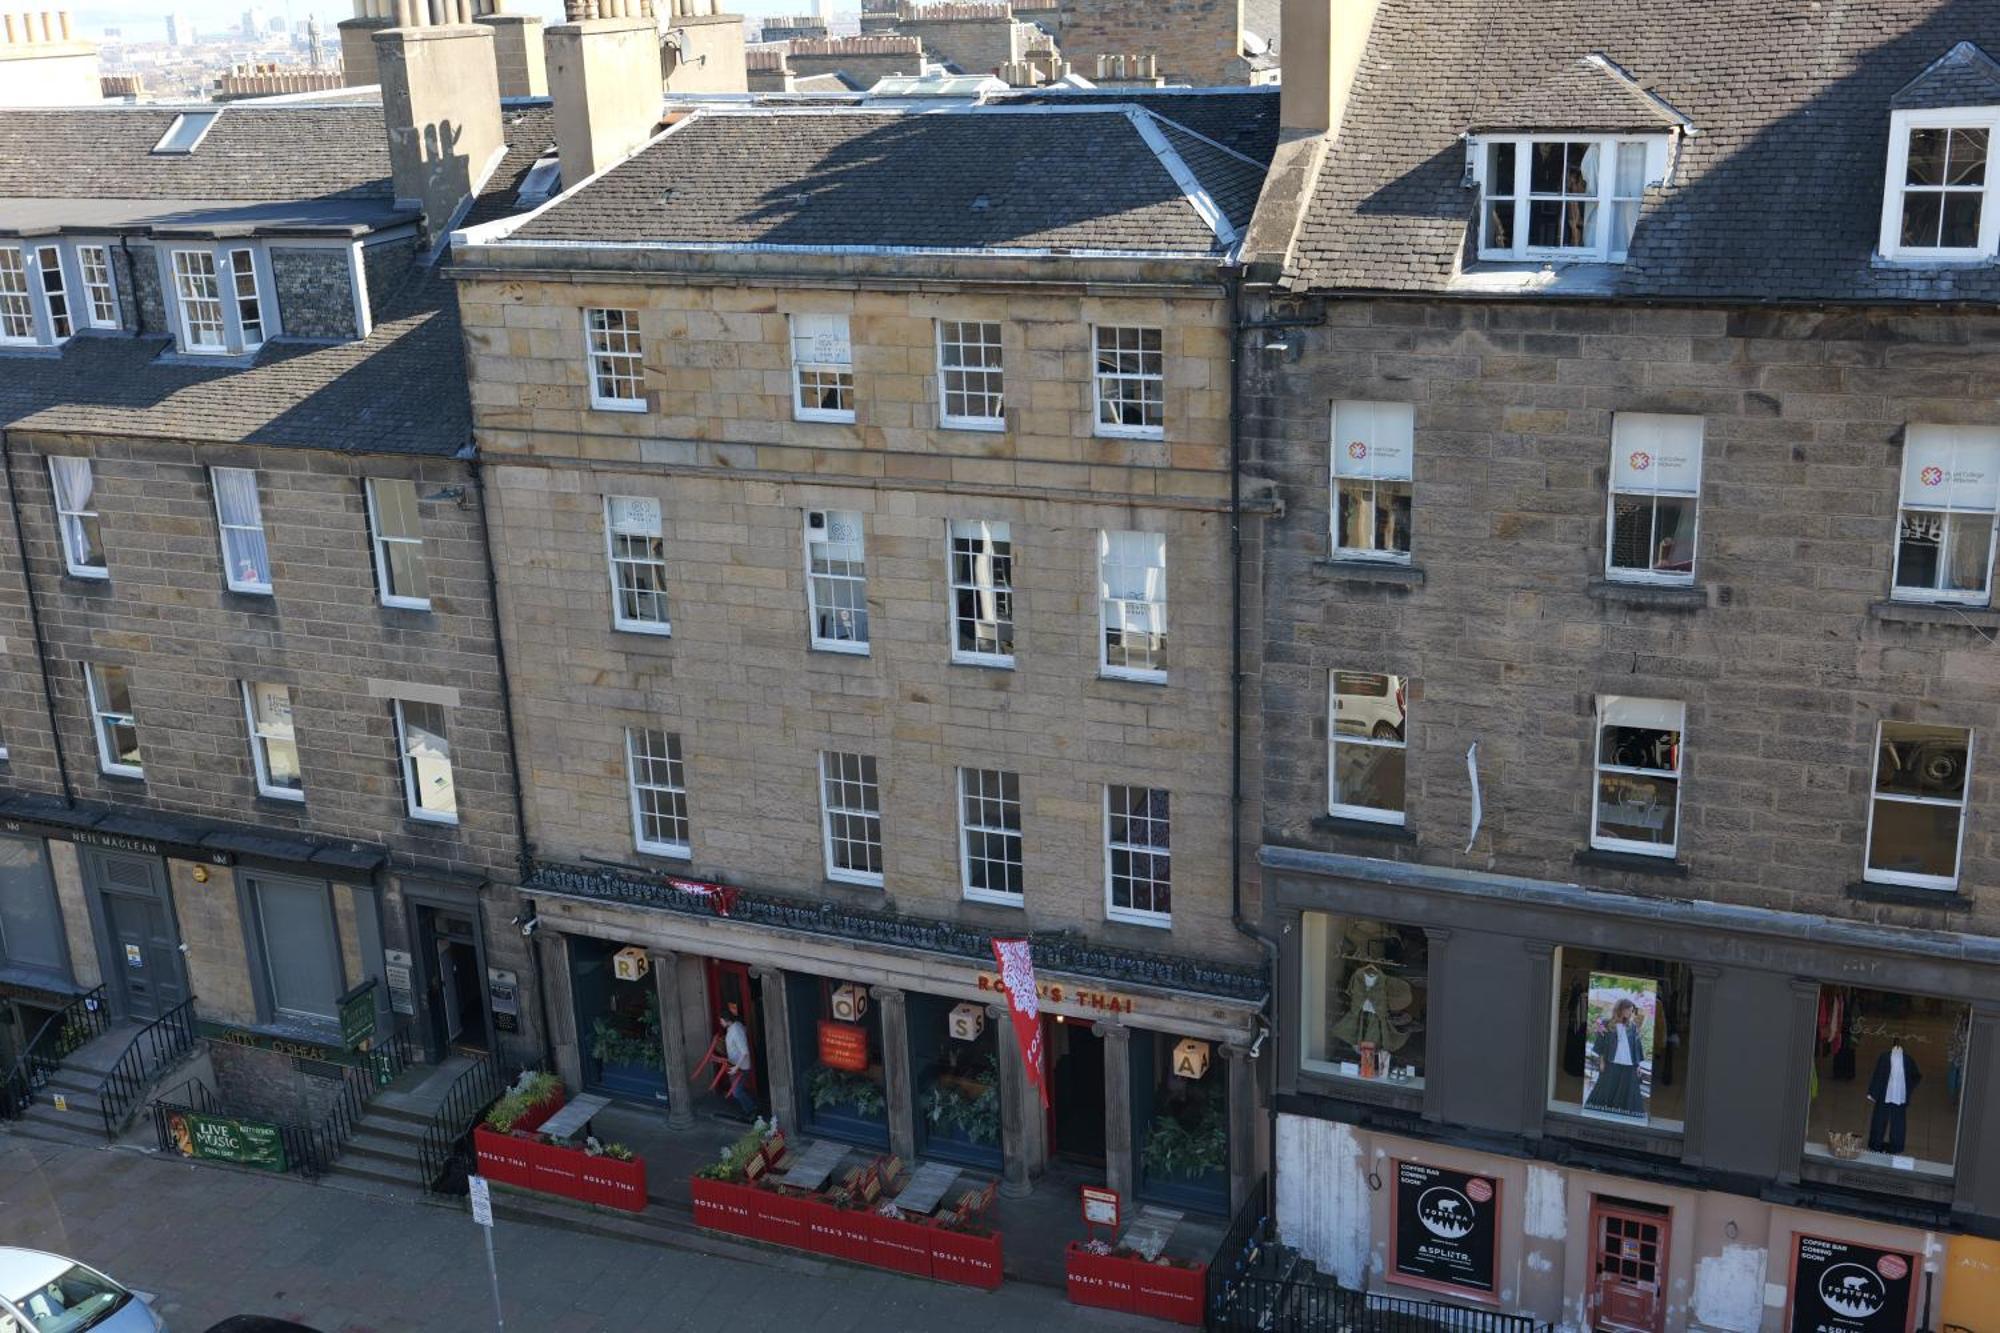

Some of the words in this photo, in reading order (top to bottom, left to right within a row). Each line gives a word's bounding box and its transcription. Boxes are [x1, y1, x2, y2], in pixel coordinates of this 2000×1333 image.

[72, 832, 97, 844] NEIL
[102, 836, 157, 853] MACLEAN
[618, 961, 629, 976] R
[978, 976, 1063, 1003] RO'S
[1076, 991, 1133, 1014] THAI
[835, 1000, 853, 1017] O
[956, 1019, 968, 1037] S
[1178, 1056, 1195, 1075] A
[200, 1123, 229, 1138] LIVE
[196, 1132, 240, 1149] MUSIC
[478, 1151, 505, 1163] ROSA'S
[508, 1157, 527, 1168] THAI
[1401, 1164, 1425, 1174] COFFEE
[1426, 1168, 1440, 1176] BAR
[1401, 1170, 1427, 1180] COMING
[583, 1174, 613, 1187] ROSA'S
[616, 1181, 635, 1192] THAI
[694, 1199, 724, 1211] ROSA'S
[728, 1205, 748, 1216] THAI
[811, 1223, 843, 1237] ROSA'S
[846, 1231, 868, 1242] THAI
[1802, 1238, 1831, 1249] COFFEE
[1832, 1244, 1848, 1252] BAR
[1802, 1245, 1832, 1256] COMING
[932, 1251, 966, 1264] ROSA'S
[969, 1259, 993, 1270] THAI
[1068, 1273, 1103, 1286] ROSA'S
[1108, 1280, 1131, 1291] THAI
[1827, 1285, 1878, 1301] FORTUNA
